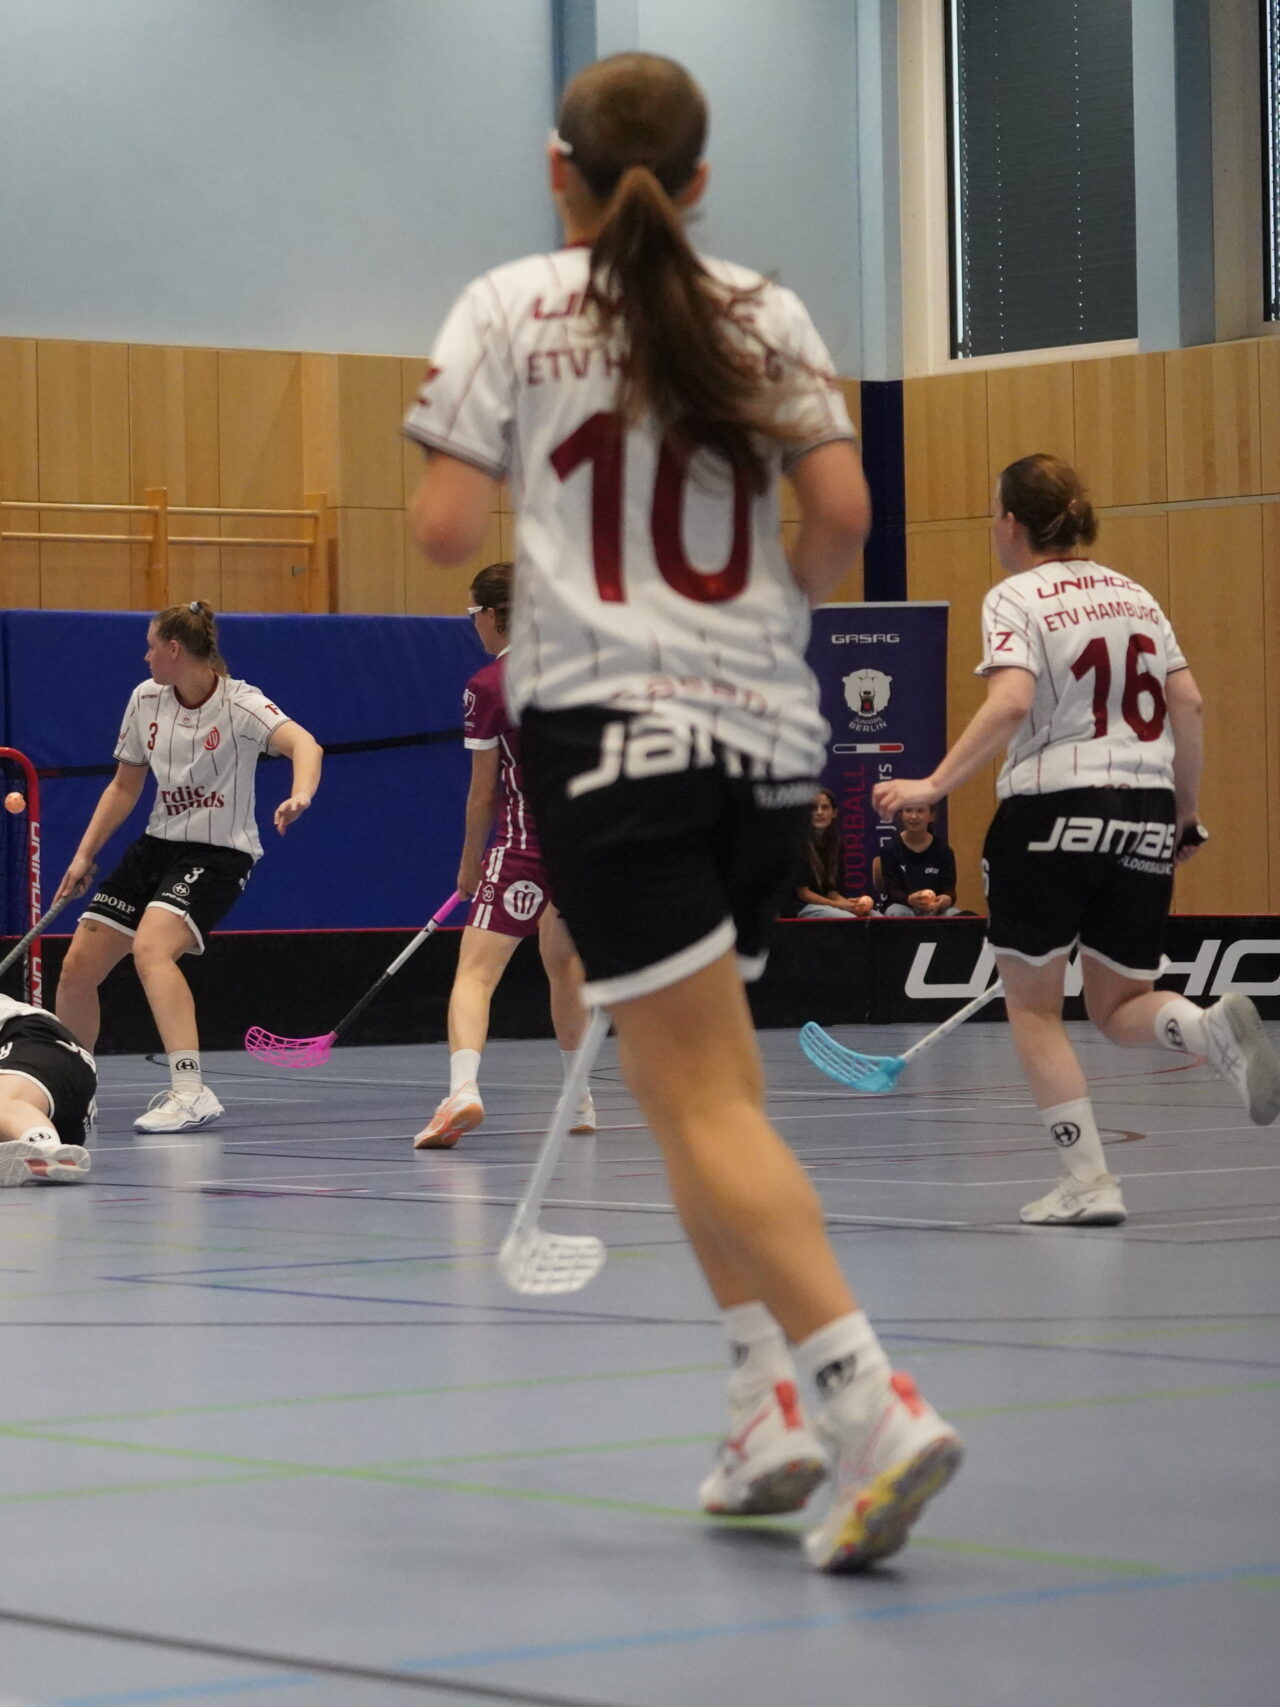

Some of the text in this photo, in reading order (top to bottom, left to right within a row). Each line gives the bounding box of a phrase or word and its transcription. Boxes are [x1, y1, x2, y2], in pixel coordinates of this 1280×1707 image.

[528, 350, 589, 386] ETV
[550, 411, 753, 606] 10
[1037, 575, 1142, 599] UNIHOC
[1043, 601, 1160, 632] ETV HAMBURG
[831, 633, 900, 644] GASAG
[1070, 633, 1167, 742] 16
[147, 722, 159, 751] 3
[847, 720, 888, 733] BERLIN
[160, 785, 206, 804] rdic
[843, 764, 866, 890] OORBALL
[183, 866, 206, 884] 3
